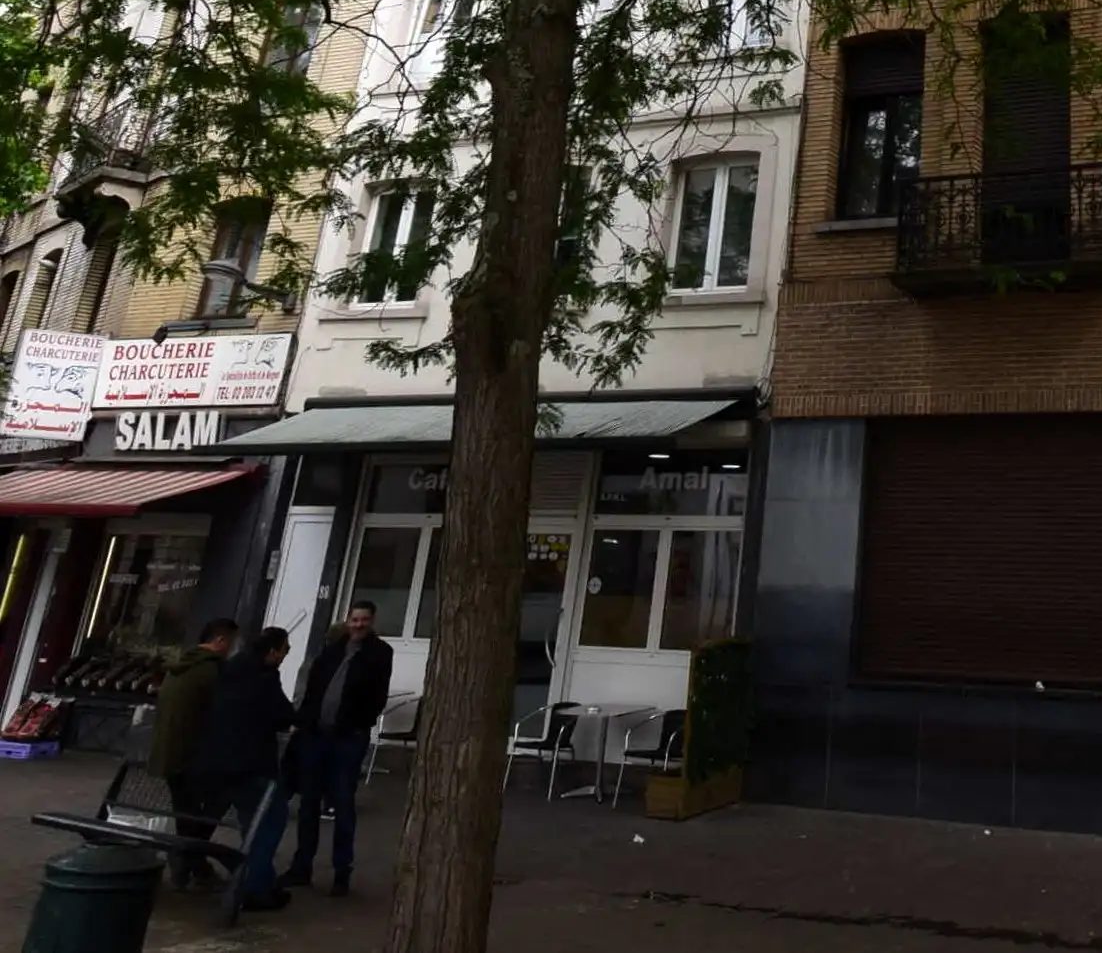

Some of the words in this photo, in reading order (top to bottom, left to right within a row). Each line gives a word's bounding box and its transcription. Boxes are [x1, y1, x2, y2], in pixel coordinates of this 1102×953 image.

[30, 332, 103, 348] BOUCHERIE
[26, 346, 99, 362] CHARCUTERIE
[113, 342, 215, 361] BOUCHERIE
[109, 362, 210, 381] CHARCUTERIE
[115, 411, 219, 451] SALAM
[408, 467, 449, 490] Caf
[638, 465, 711, 492] Amal
